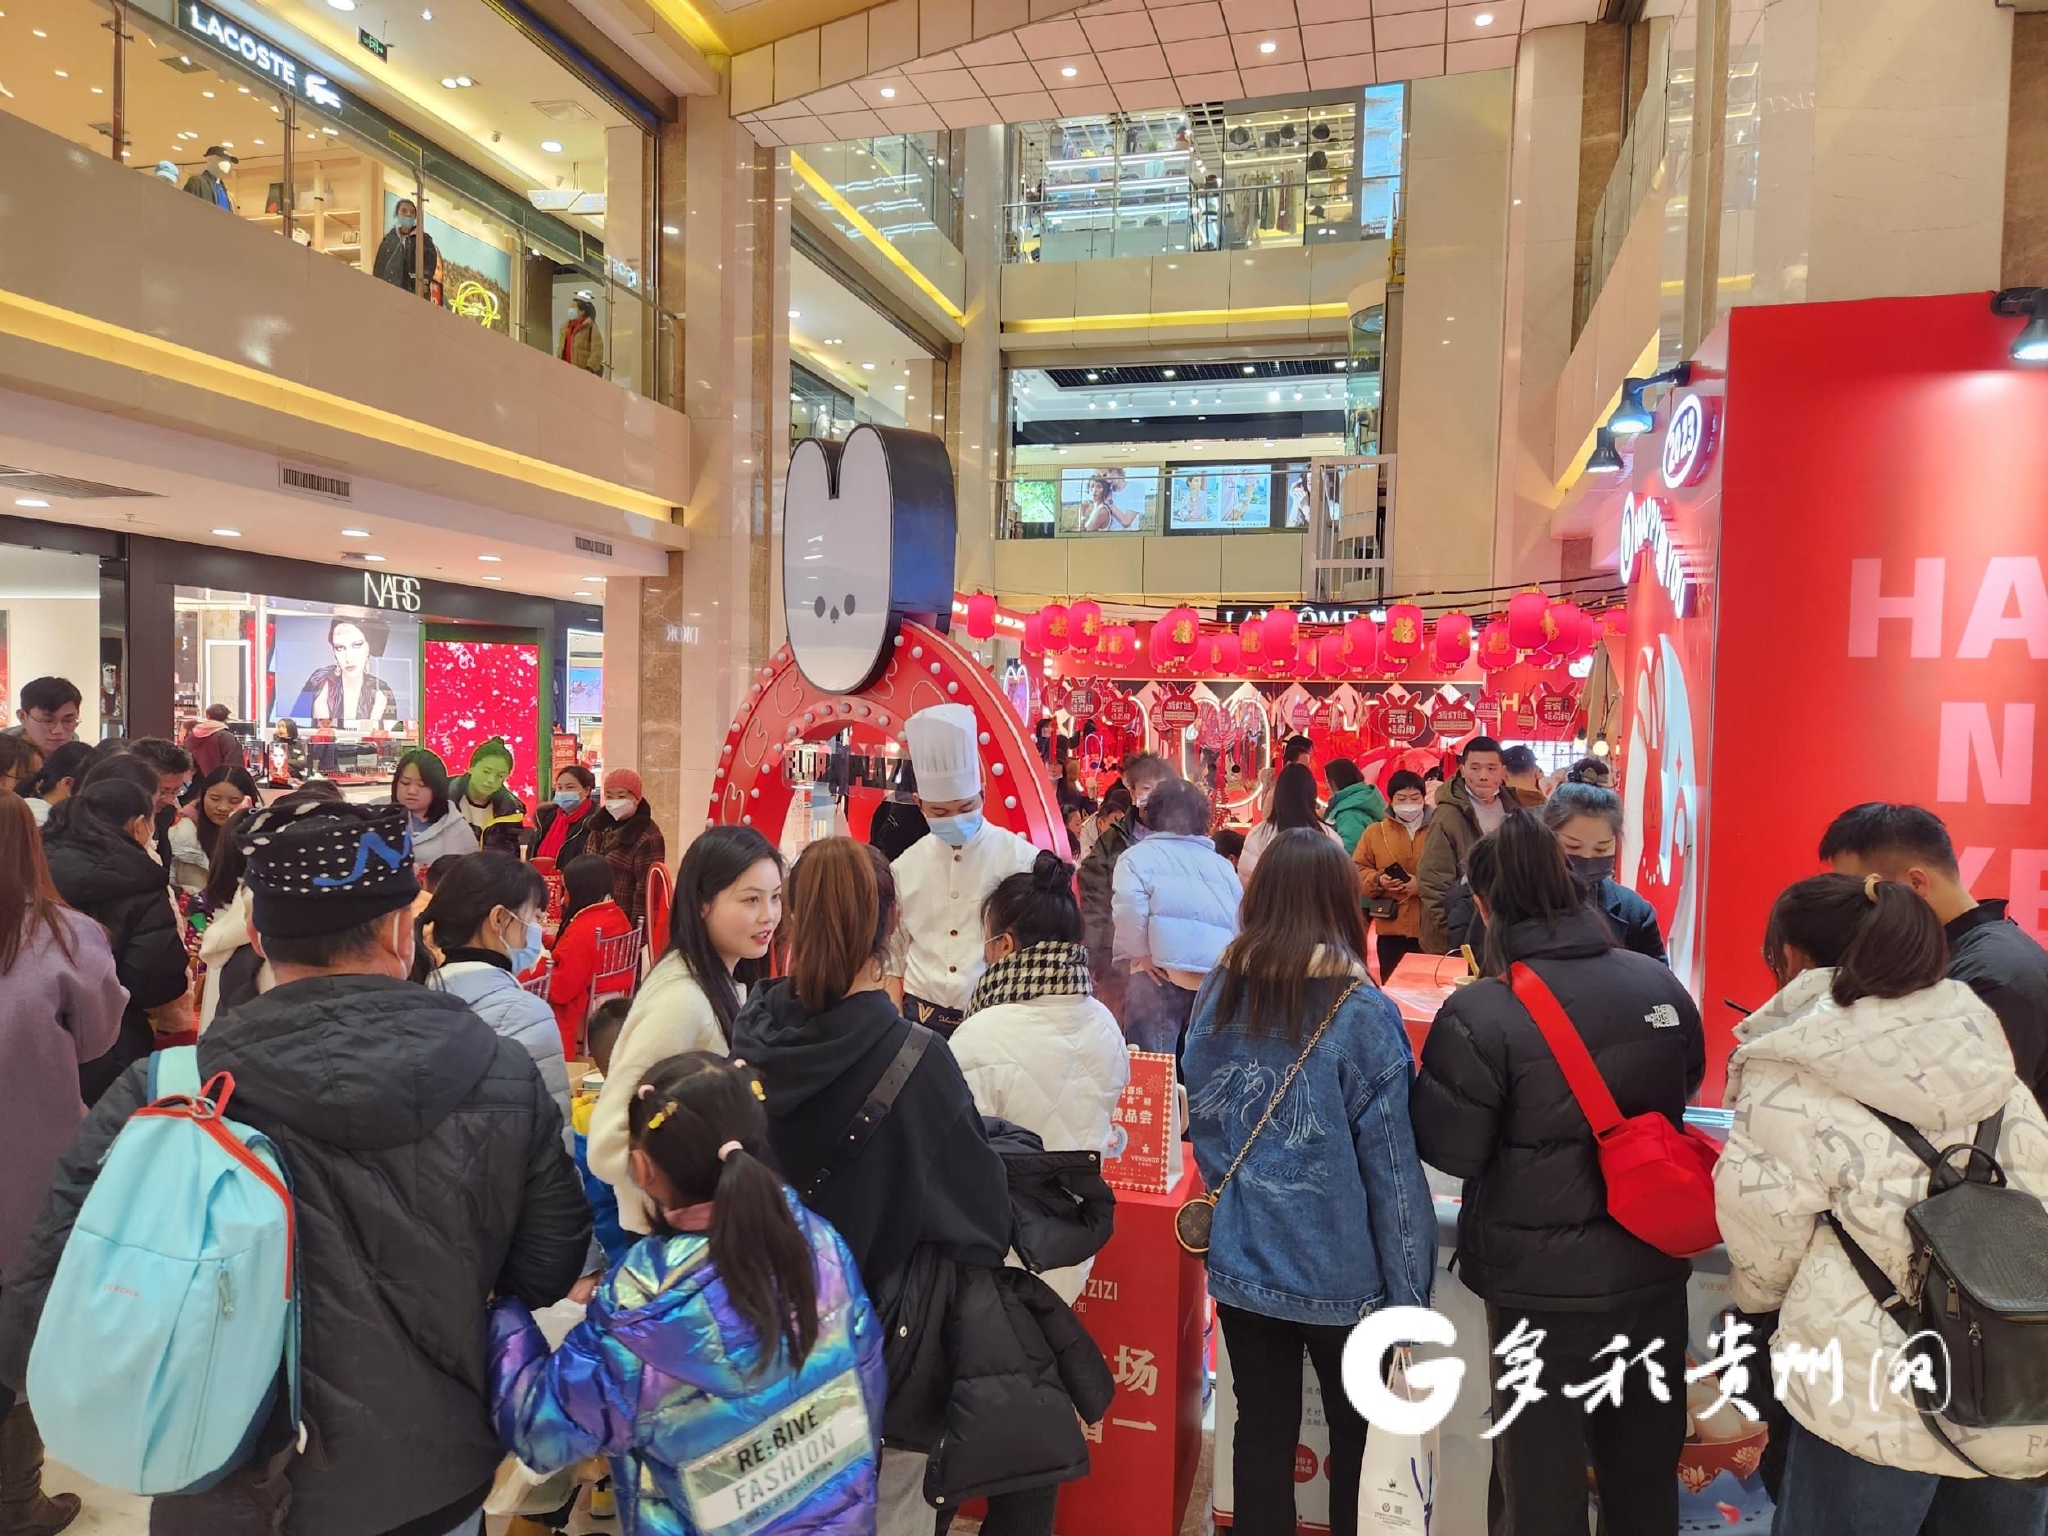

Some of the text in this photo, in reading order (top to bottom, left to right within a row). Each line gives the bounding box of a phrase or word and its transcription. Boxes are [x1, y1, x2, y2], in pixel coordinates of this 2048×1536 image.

[189, 5, 296, 86] LACOSTE
[1667, 408, 1697, 474] 2023
[364, 571, 421, 612] NARS
[1847, 555, 2048, 660] HA
[1172, 619, 1195, 644] 福
[1391, 615, 1417, 644] 福
[1388, 714, 1406, 725] 元宵
[1544, 700, 1562, 711] 元宵
[1937, 702, 2036, 805] N
[1102, 1343, 1159, 1397] 场
[733, 1427, 837, 1511] FASHION
